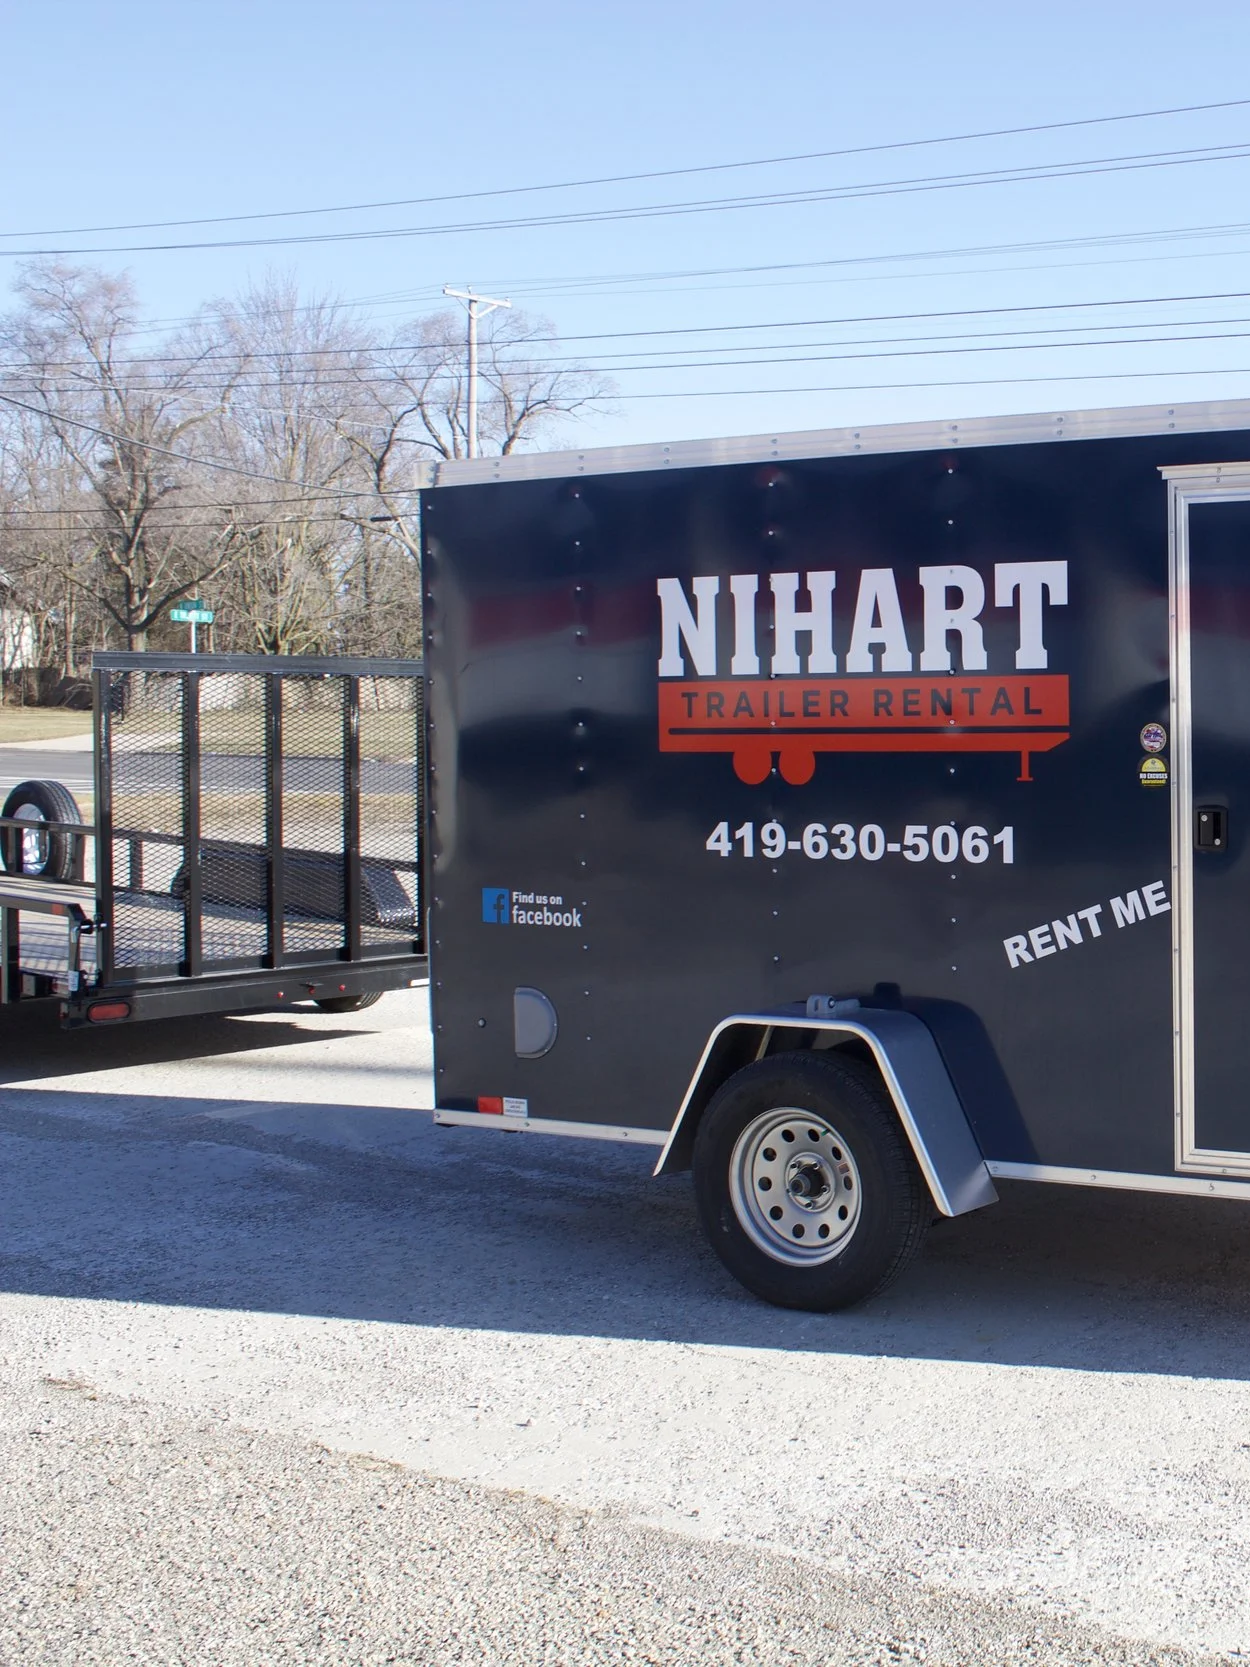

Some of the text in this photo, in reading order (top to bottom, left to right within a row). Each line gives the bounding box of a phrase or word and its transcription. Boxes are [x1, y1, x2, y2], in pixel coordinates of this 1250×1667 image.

[657, 560, 1068, 677] NIHART
[681, 686, 1042, 718] TRAILER RENTAL
[706, 821, 1014, 864] 419-630-5061
[512, 891, 563, 905] Find us on
[512, 905, 582, 927] facebook
[1003, 880, 1171, 969] RENT ME
